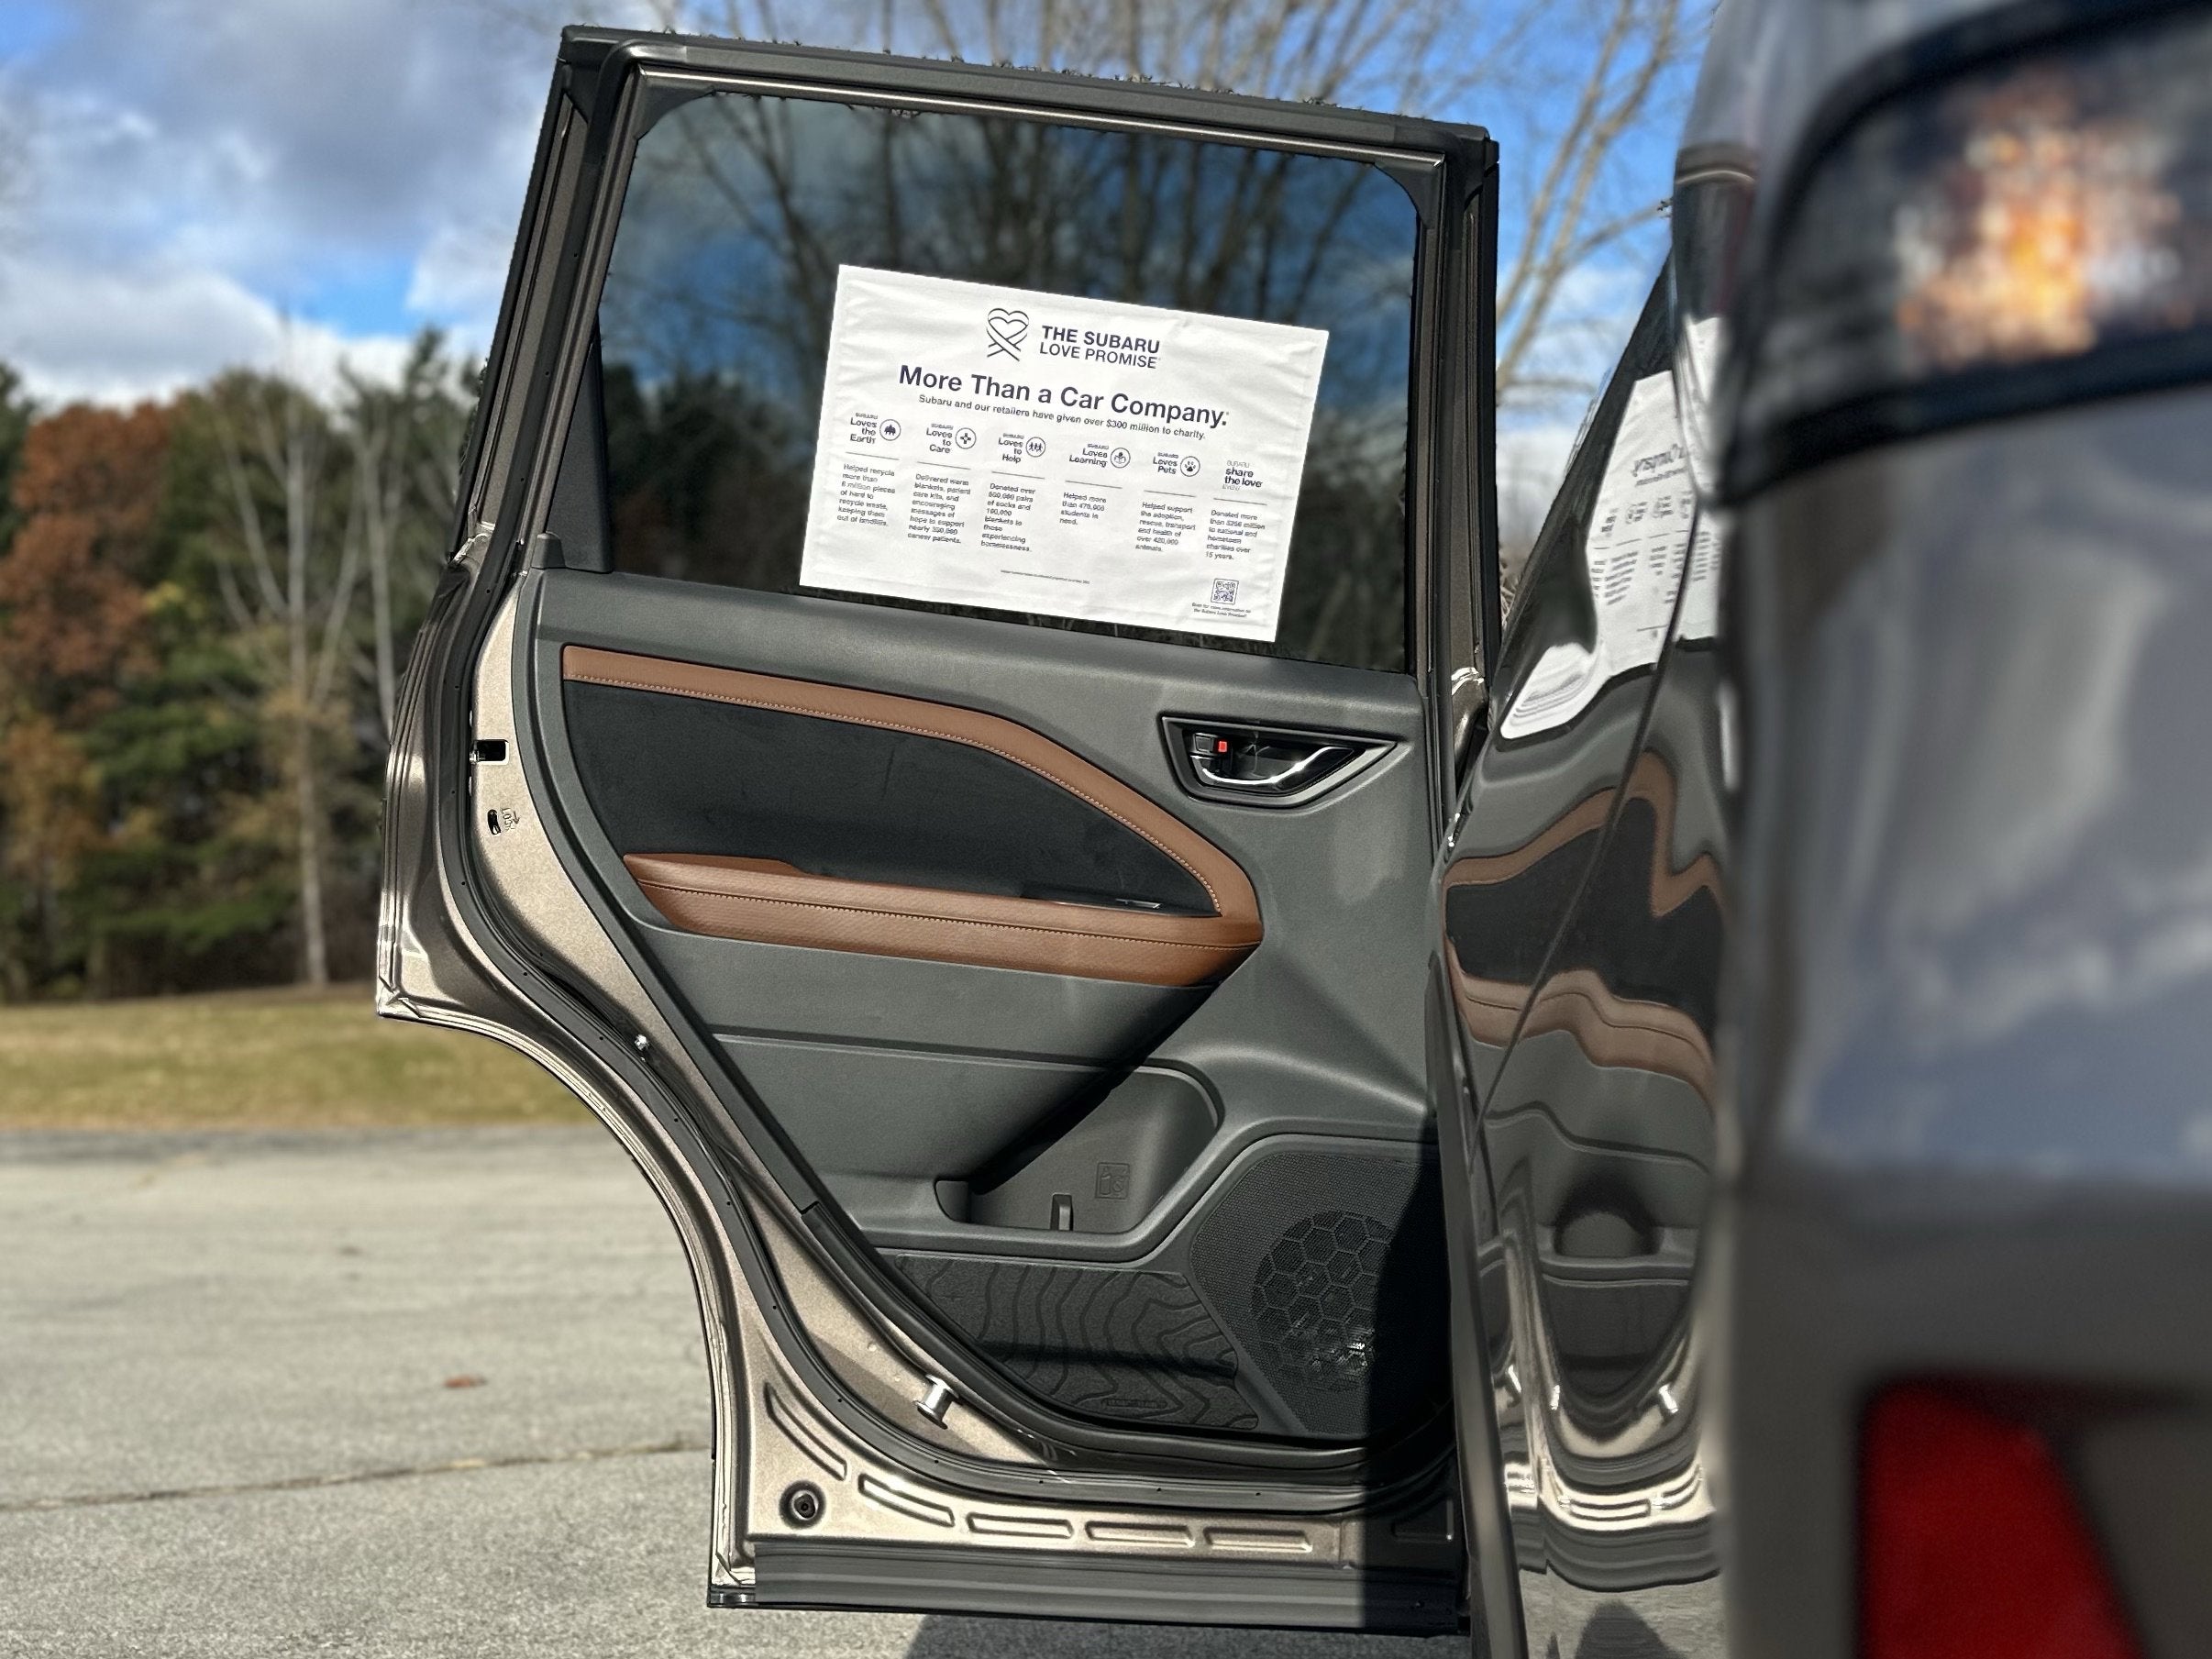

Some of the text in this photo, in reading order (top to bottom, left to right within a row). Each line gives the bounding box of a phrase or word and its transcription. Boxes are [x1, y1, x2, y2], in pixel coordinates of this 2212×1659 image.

[1042, 325, 1159, 353] THE SUBARU
[1039, 341, 1156, 369] LOVE PROMISE
[899, 364, 1227, 428] More Than a Car Company.
[918, 393, 1205, 440] Subaru and our retailers have given over $300 million to charity.
[850, 417, 877, 428] Loves
[862, 427, 876, 436] the
[926, 427, 953, 438] Loves
[850, 434, 876, 444] Earth
[998, 437, 1023, 448] Loves
[929, 444, 951, 454] Care
[1082, 448, 1108, 459] Loves
[1002, 454, 1021, 464] Help
[1068, 455, 1108, 468] Learning
[1153, 457, 1178, 467] Loves
[1157, 466, 1177, 475] Pets
[1225, 467, 1254, 478] share
[1224, 475, 1263, 488] the love
